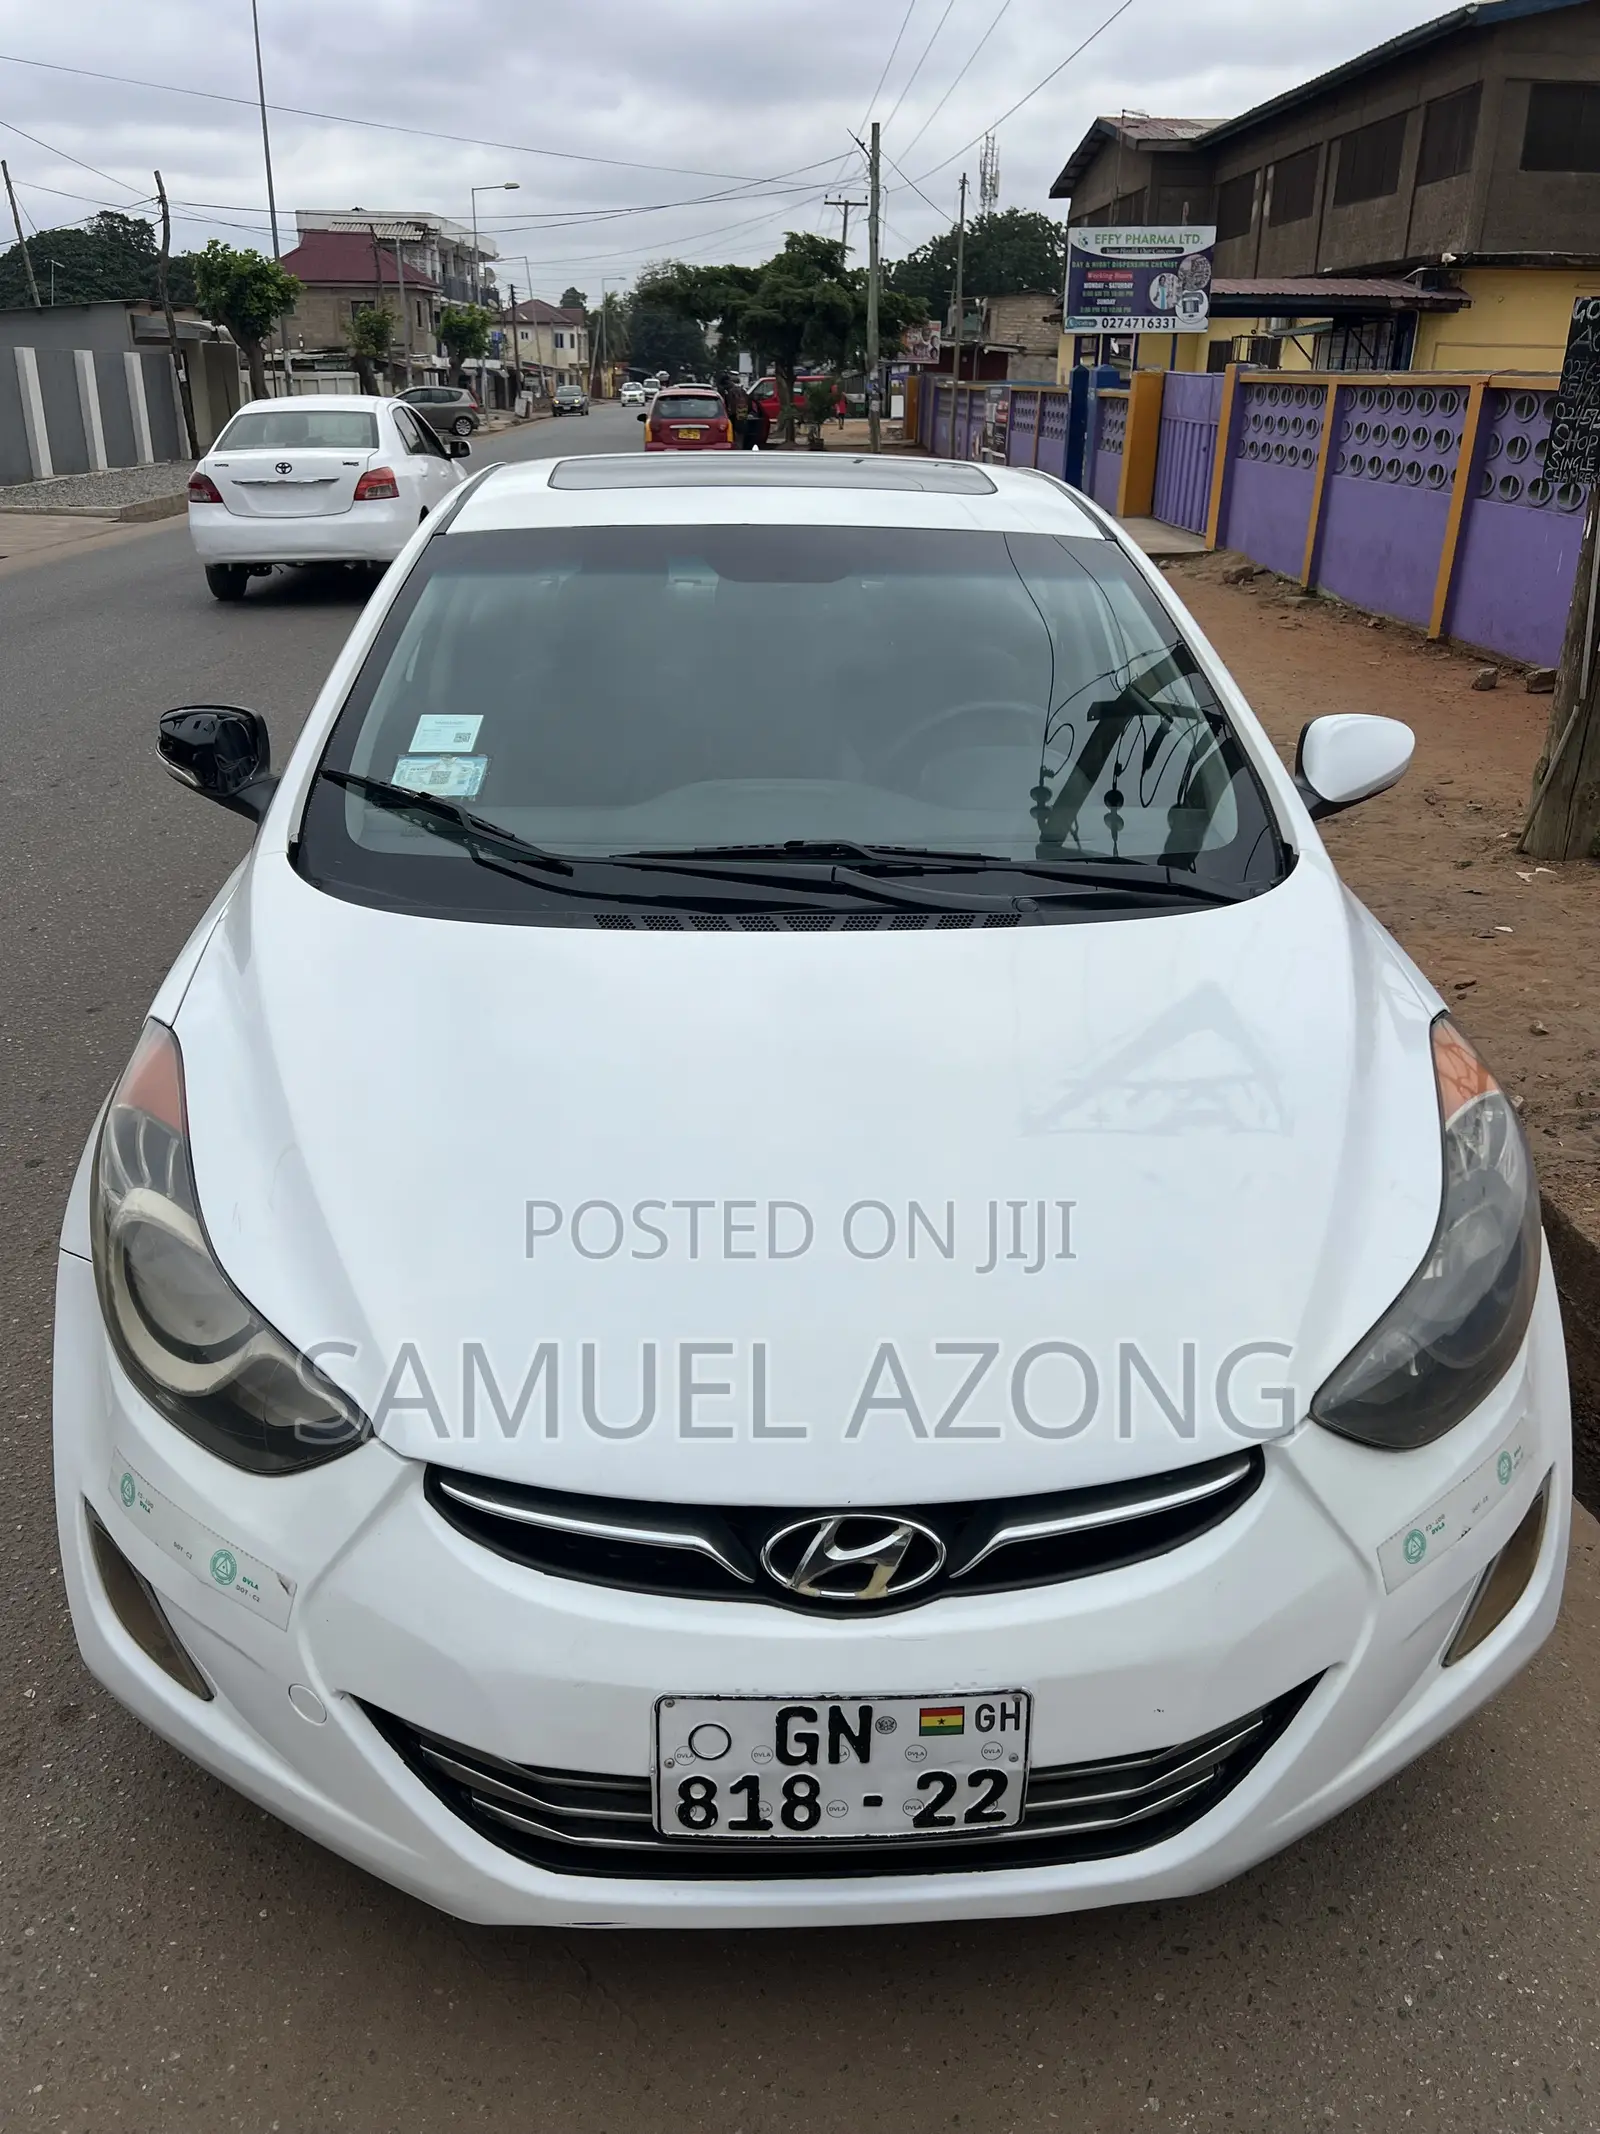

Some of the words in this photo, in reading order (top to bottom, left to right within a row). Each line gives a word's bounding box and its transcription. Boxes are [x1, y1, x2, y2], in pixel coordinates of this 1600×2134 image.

[1094, 233, 1122, 245] EFFY
[1125, 233, 1176, 245] PHARMA
[1178, 233, 1204, 245] LTD.
[1087, 271, 1114, 281] Working
[1101, 317, 1176, 329] 0274716331
[1547, 450, 1596, 472] SINGLE
[242, 1576, 259, 1591] DVLA
[974, 1701, 1021, 1733] GH
[774, 1704, 873, 1767] GN
[677, 1773, 821, 1831] 818
[862, 1794, 883, 1808] -
[911, 1768, 1009, 1829] 22
